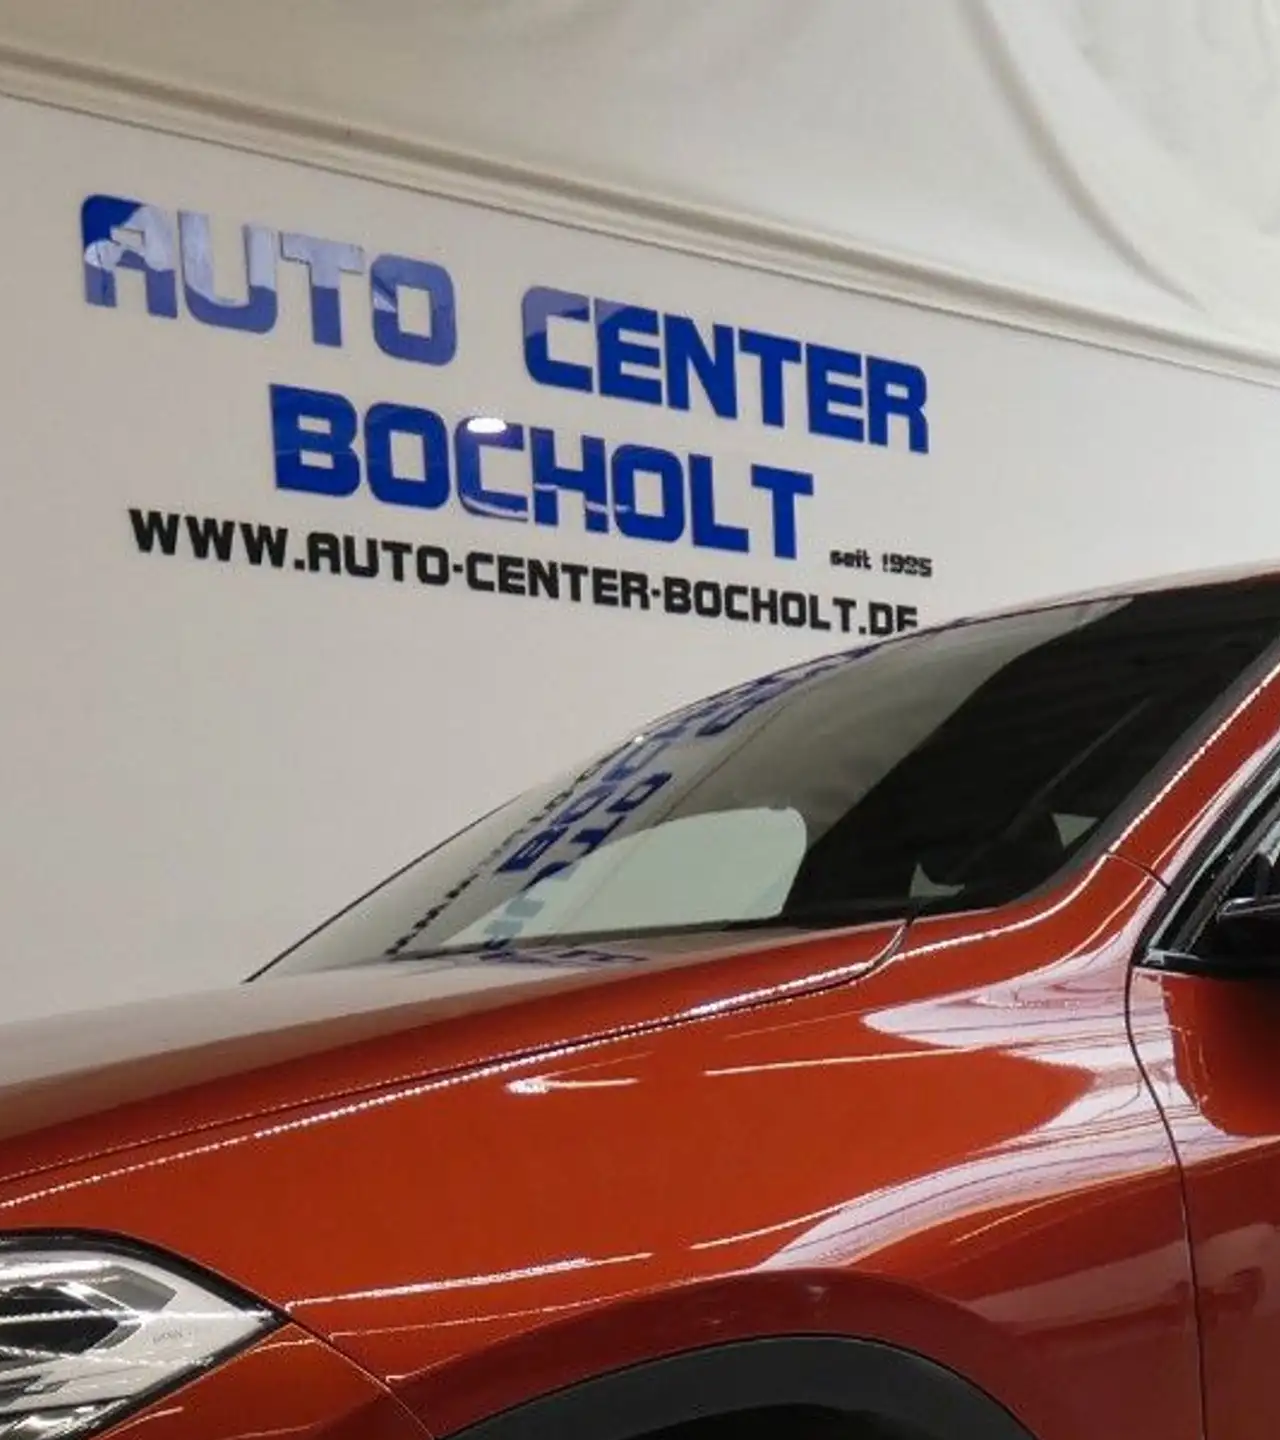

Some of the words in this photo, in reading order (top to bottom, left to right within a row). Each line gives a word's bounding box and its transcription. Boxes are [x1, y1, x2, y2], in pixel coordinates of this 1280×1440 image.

[80, 194, 458, 367] AUTO
[521, 285, 931, 456] CENTER
[269, 383, 817, 561] BOCHOLT
[128, 508, 918, 637] WWW.AUTO-CENTER-BOCHOLT.DE
